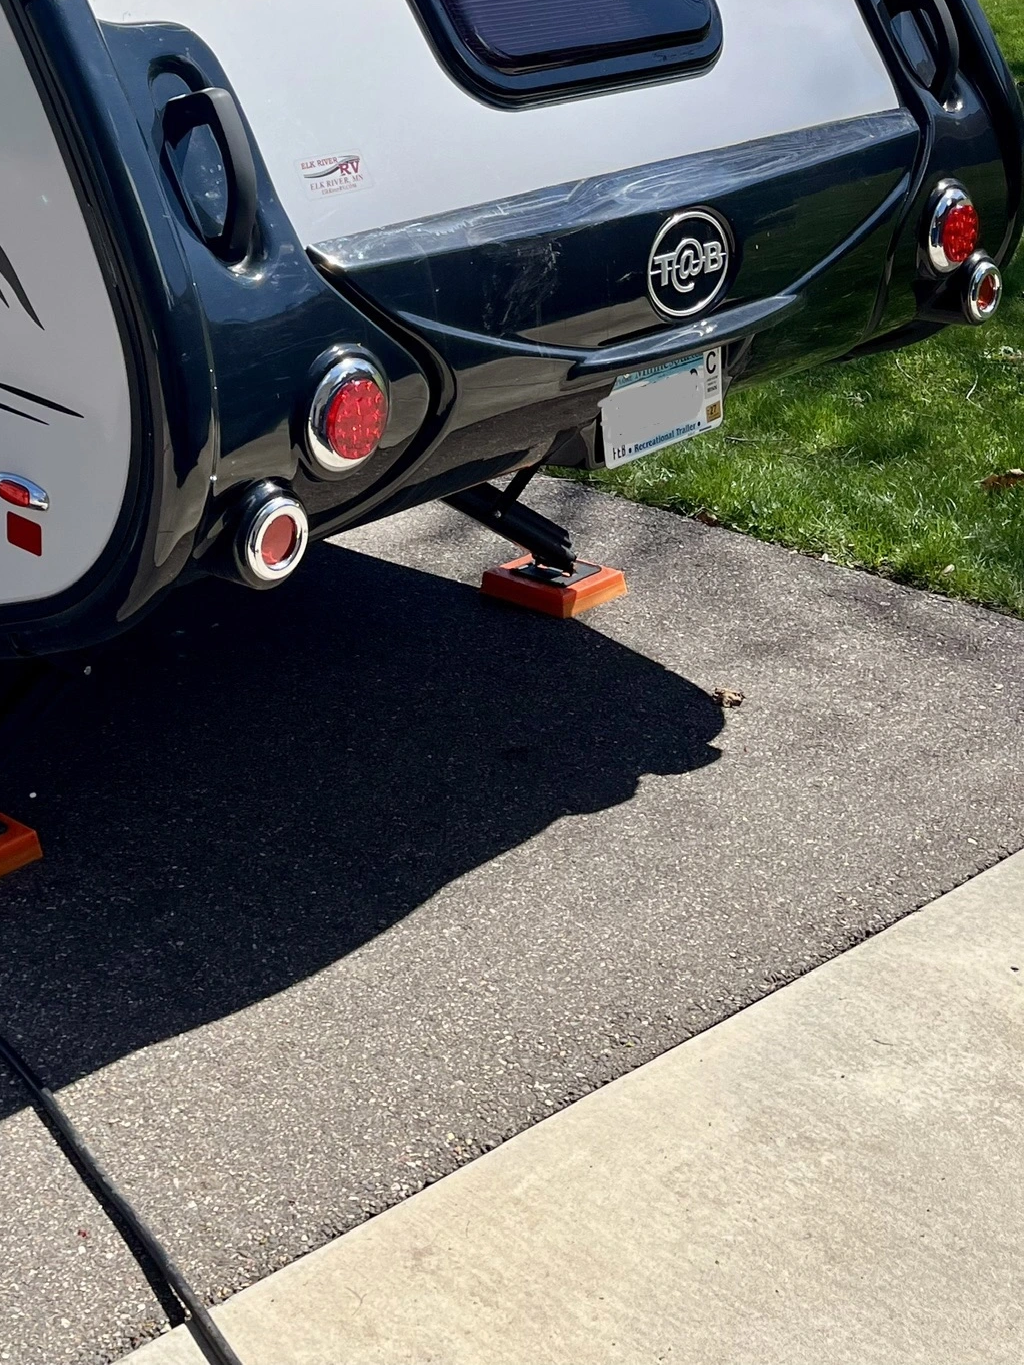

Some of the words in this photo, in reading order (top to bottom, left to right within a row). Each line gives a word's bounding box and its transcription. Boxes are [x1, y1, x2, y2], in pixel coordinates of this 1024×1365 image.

[300, 161, 316, 170] ELK
[316, 156, 338, 167] RIVER
[338, 161, 360, 176] RV
[310, 181, 325, 190] ELK
[653, 238, 724, 293] T@B
[706, 351, 716, 374] C
[634, 430, 675, 452] Recreational
[676, 422, 697, 436] Trailer
